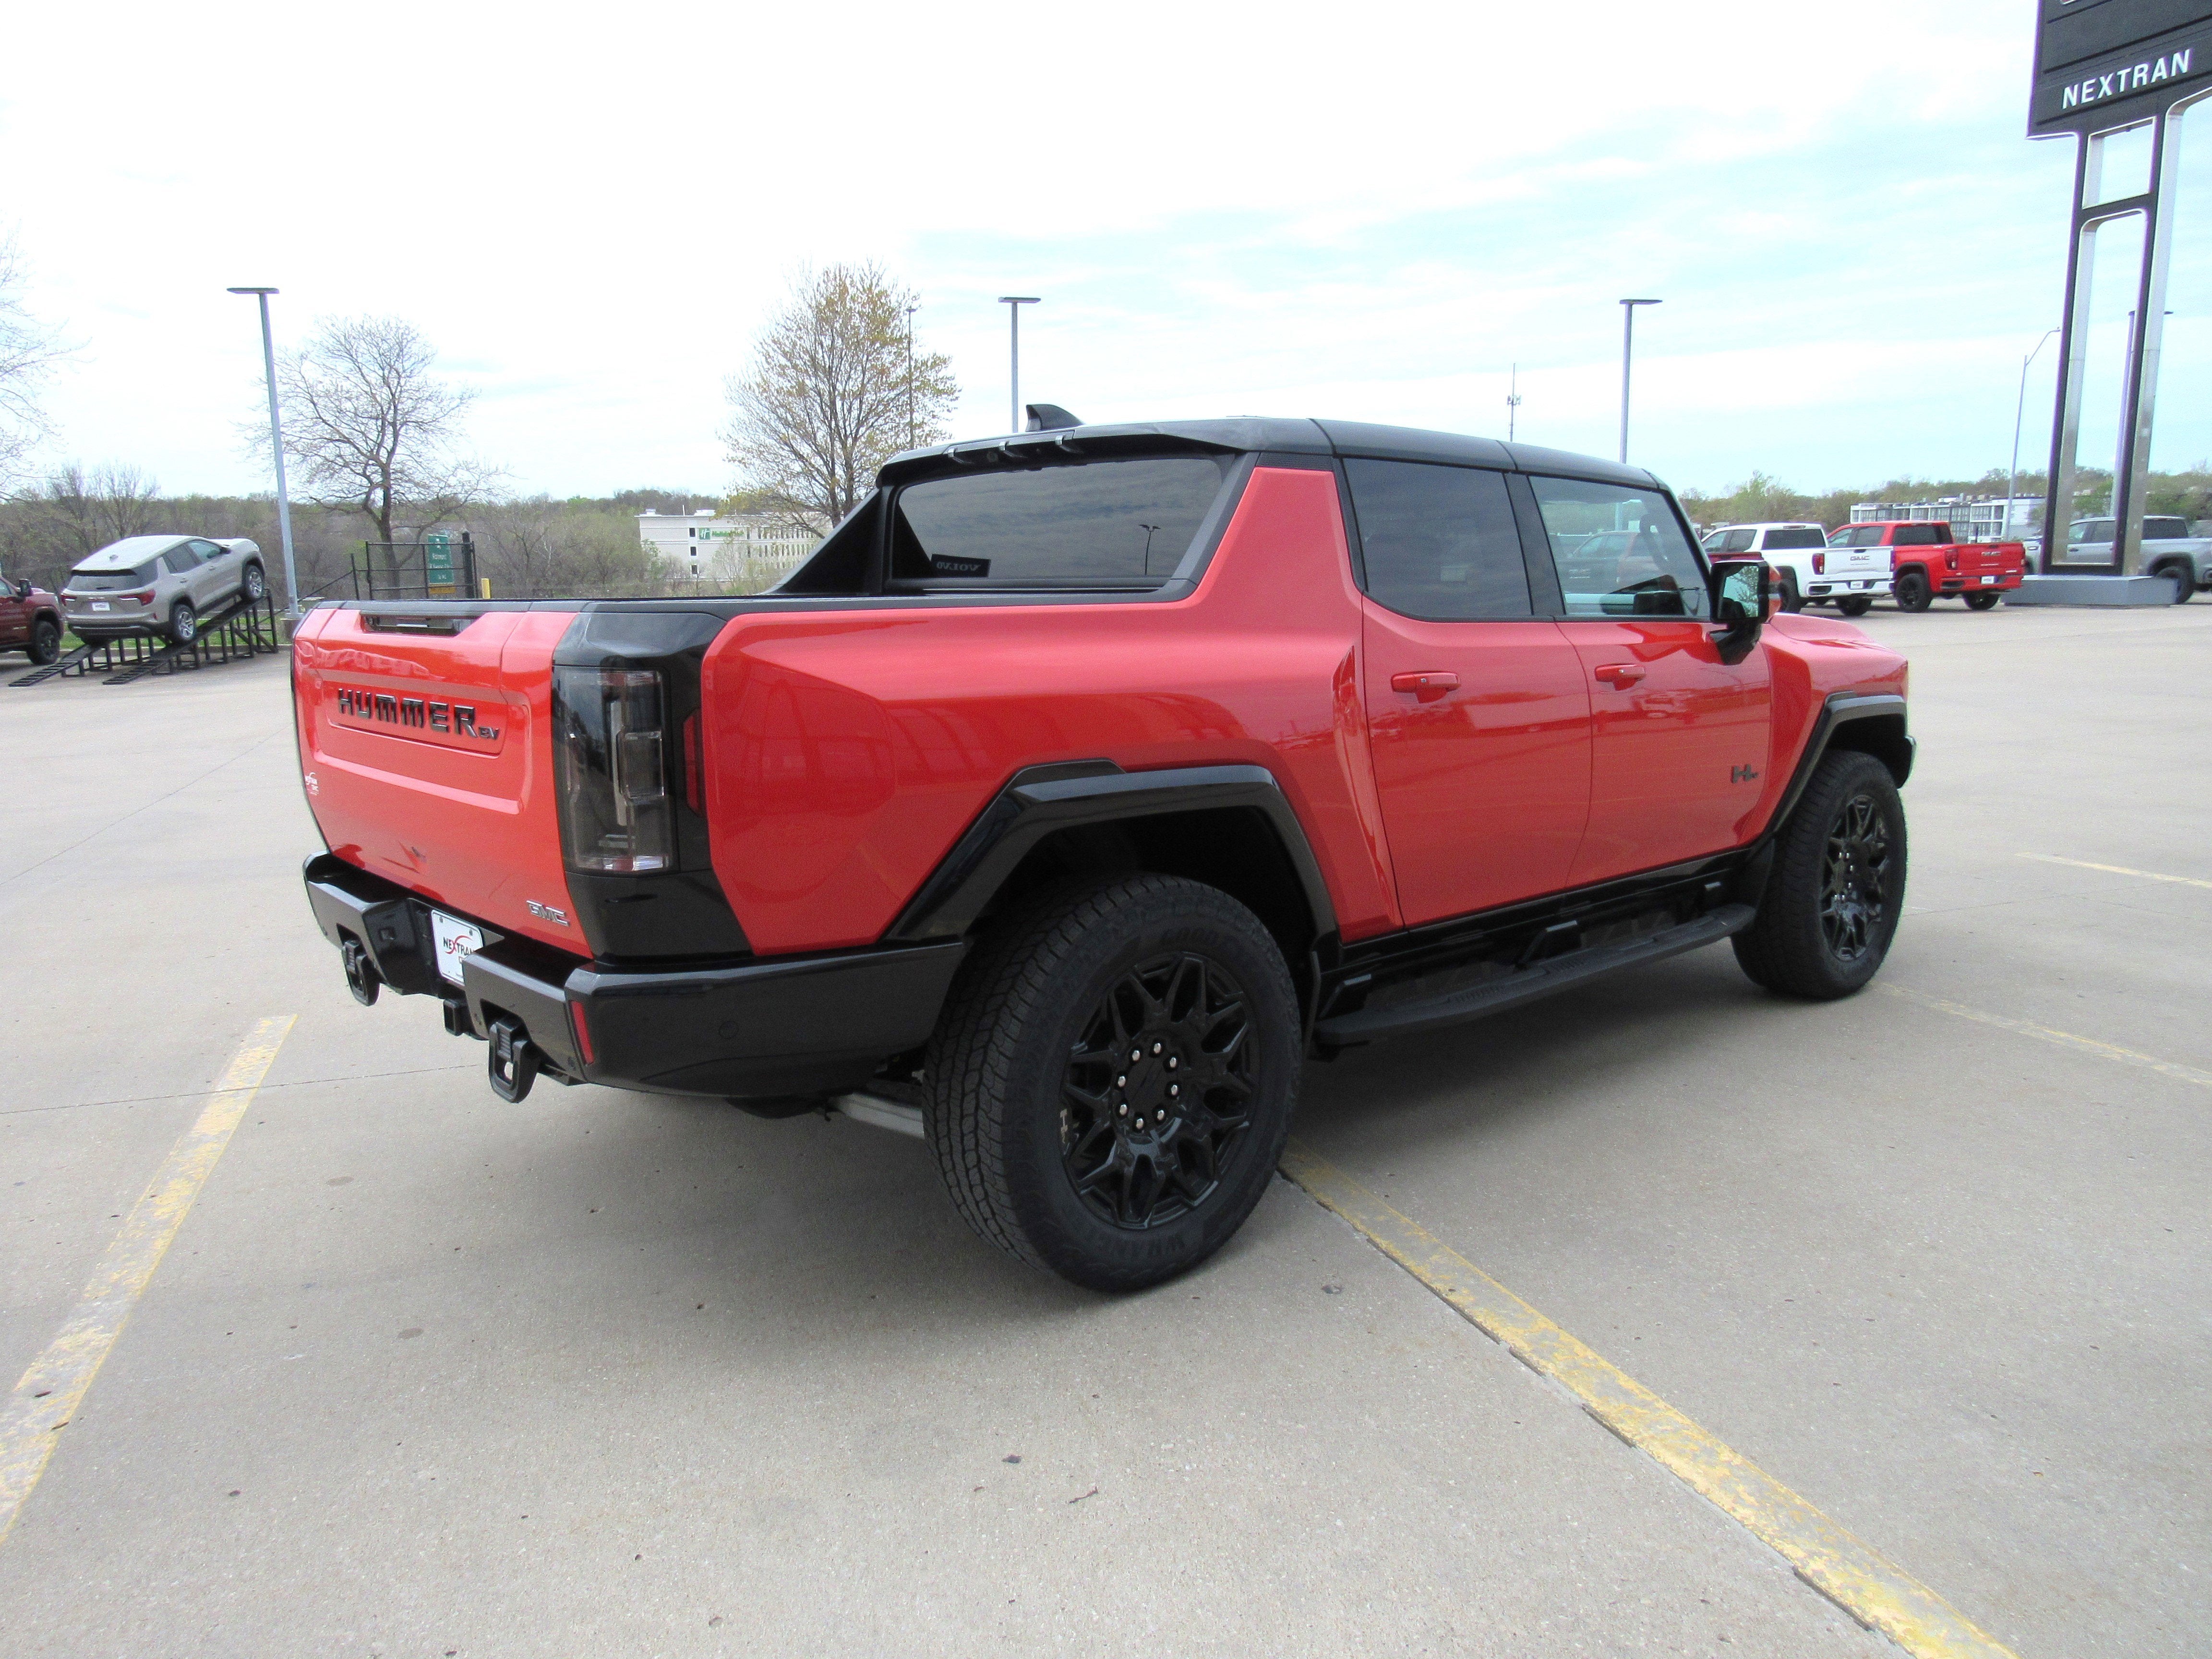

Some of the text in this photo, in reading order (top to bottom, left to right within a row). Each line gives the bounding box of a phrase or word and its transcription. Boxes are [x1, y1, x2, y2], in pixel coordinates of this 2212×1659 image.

[2062, 48, 2191, 109] NEXTRAN
[338, 688, 500, 740] HUMMER EV
[526, 900, 569, 927] GMC
